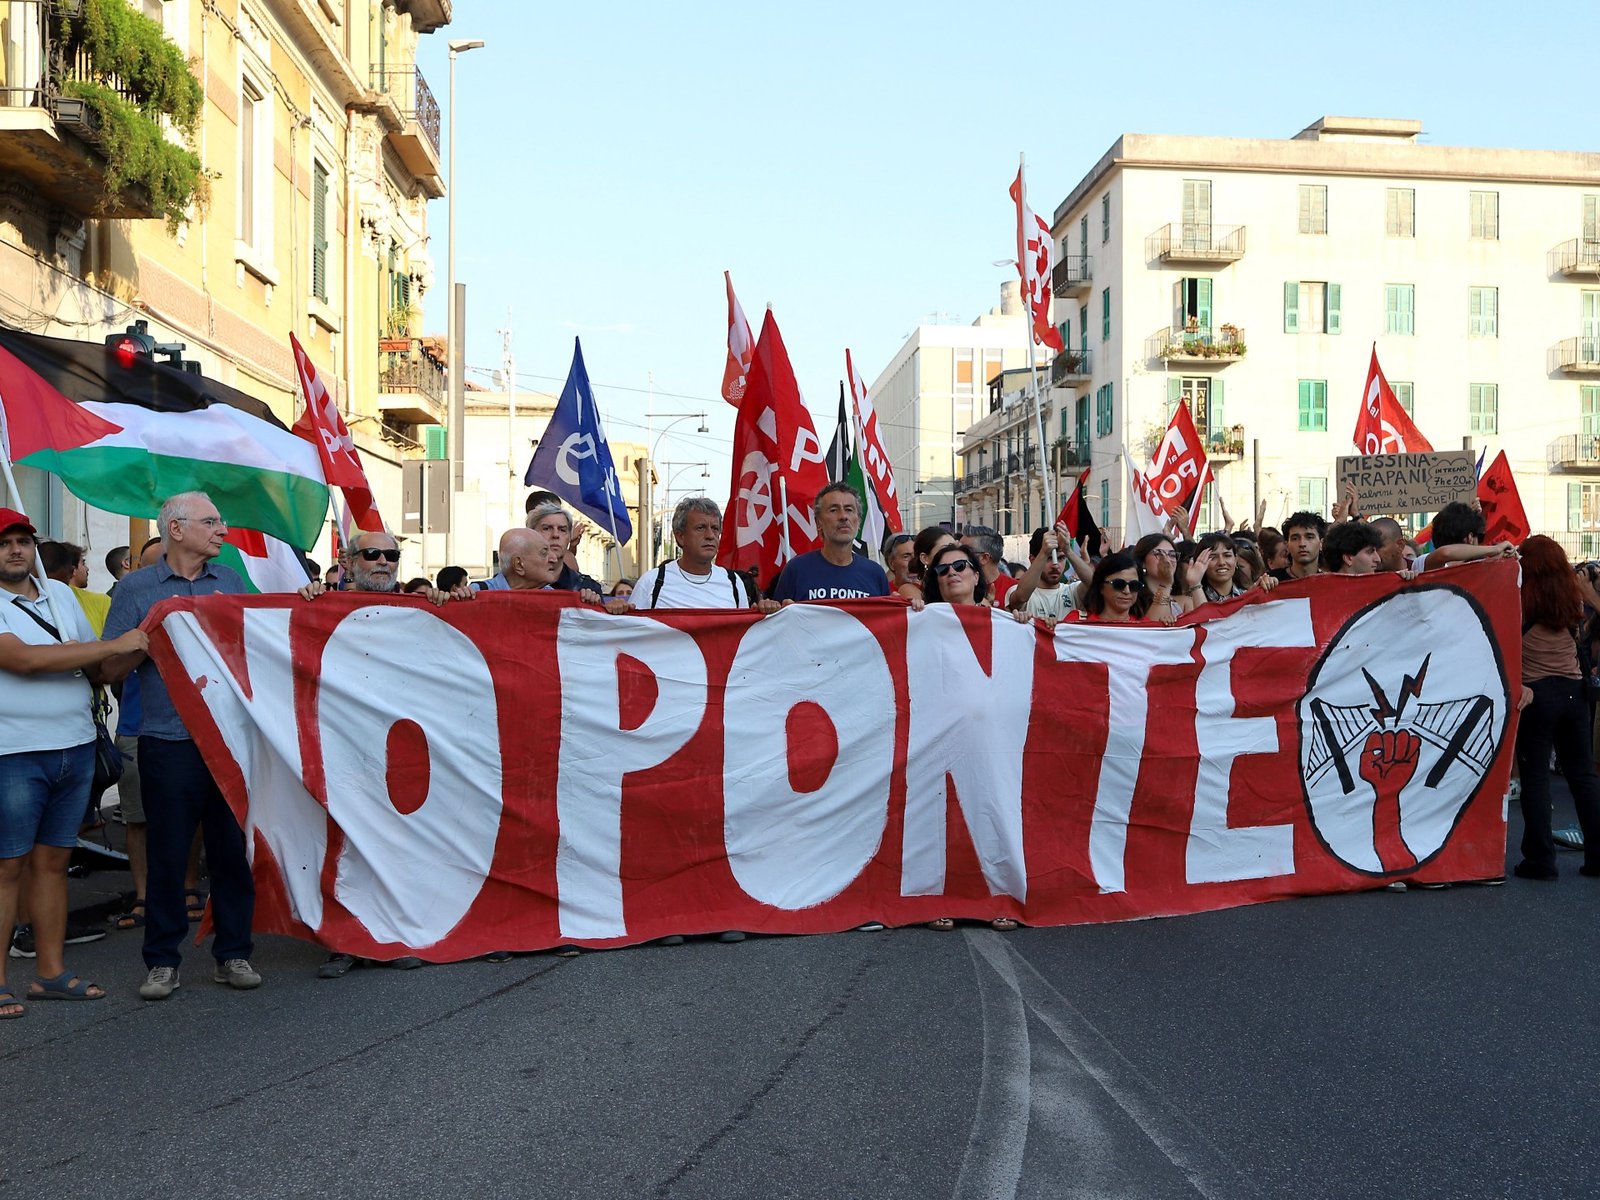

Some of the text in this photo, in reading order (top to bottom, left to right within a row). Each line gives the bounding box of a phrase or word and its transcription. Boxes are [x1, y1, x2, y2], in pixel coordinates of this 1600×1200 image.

[1343, 454, 1431, 472] MESSINA
[1347, 468, 1427, 486] TRAPANI
[808, 588, 827, 600] NO
[163, 597, 1316, 948] NO PONTE
